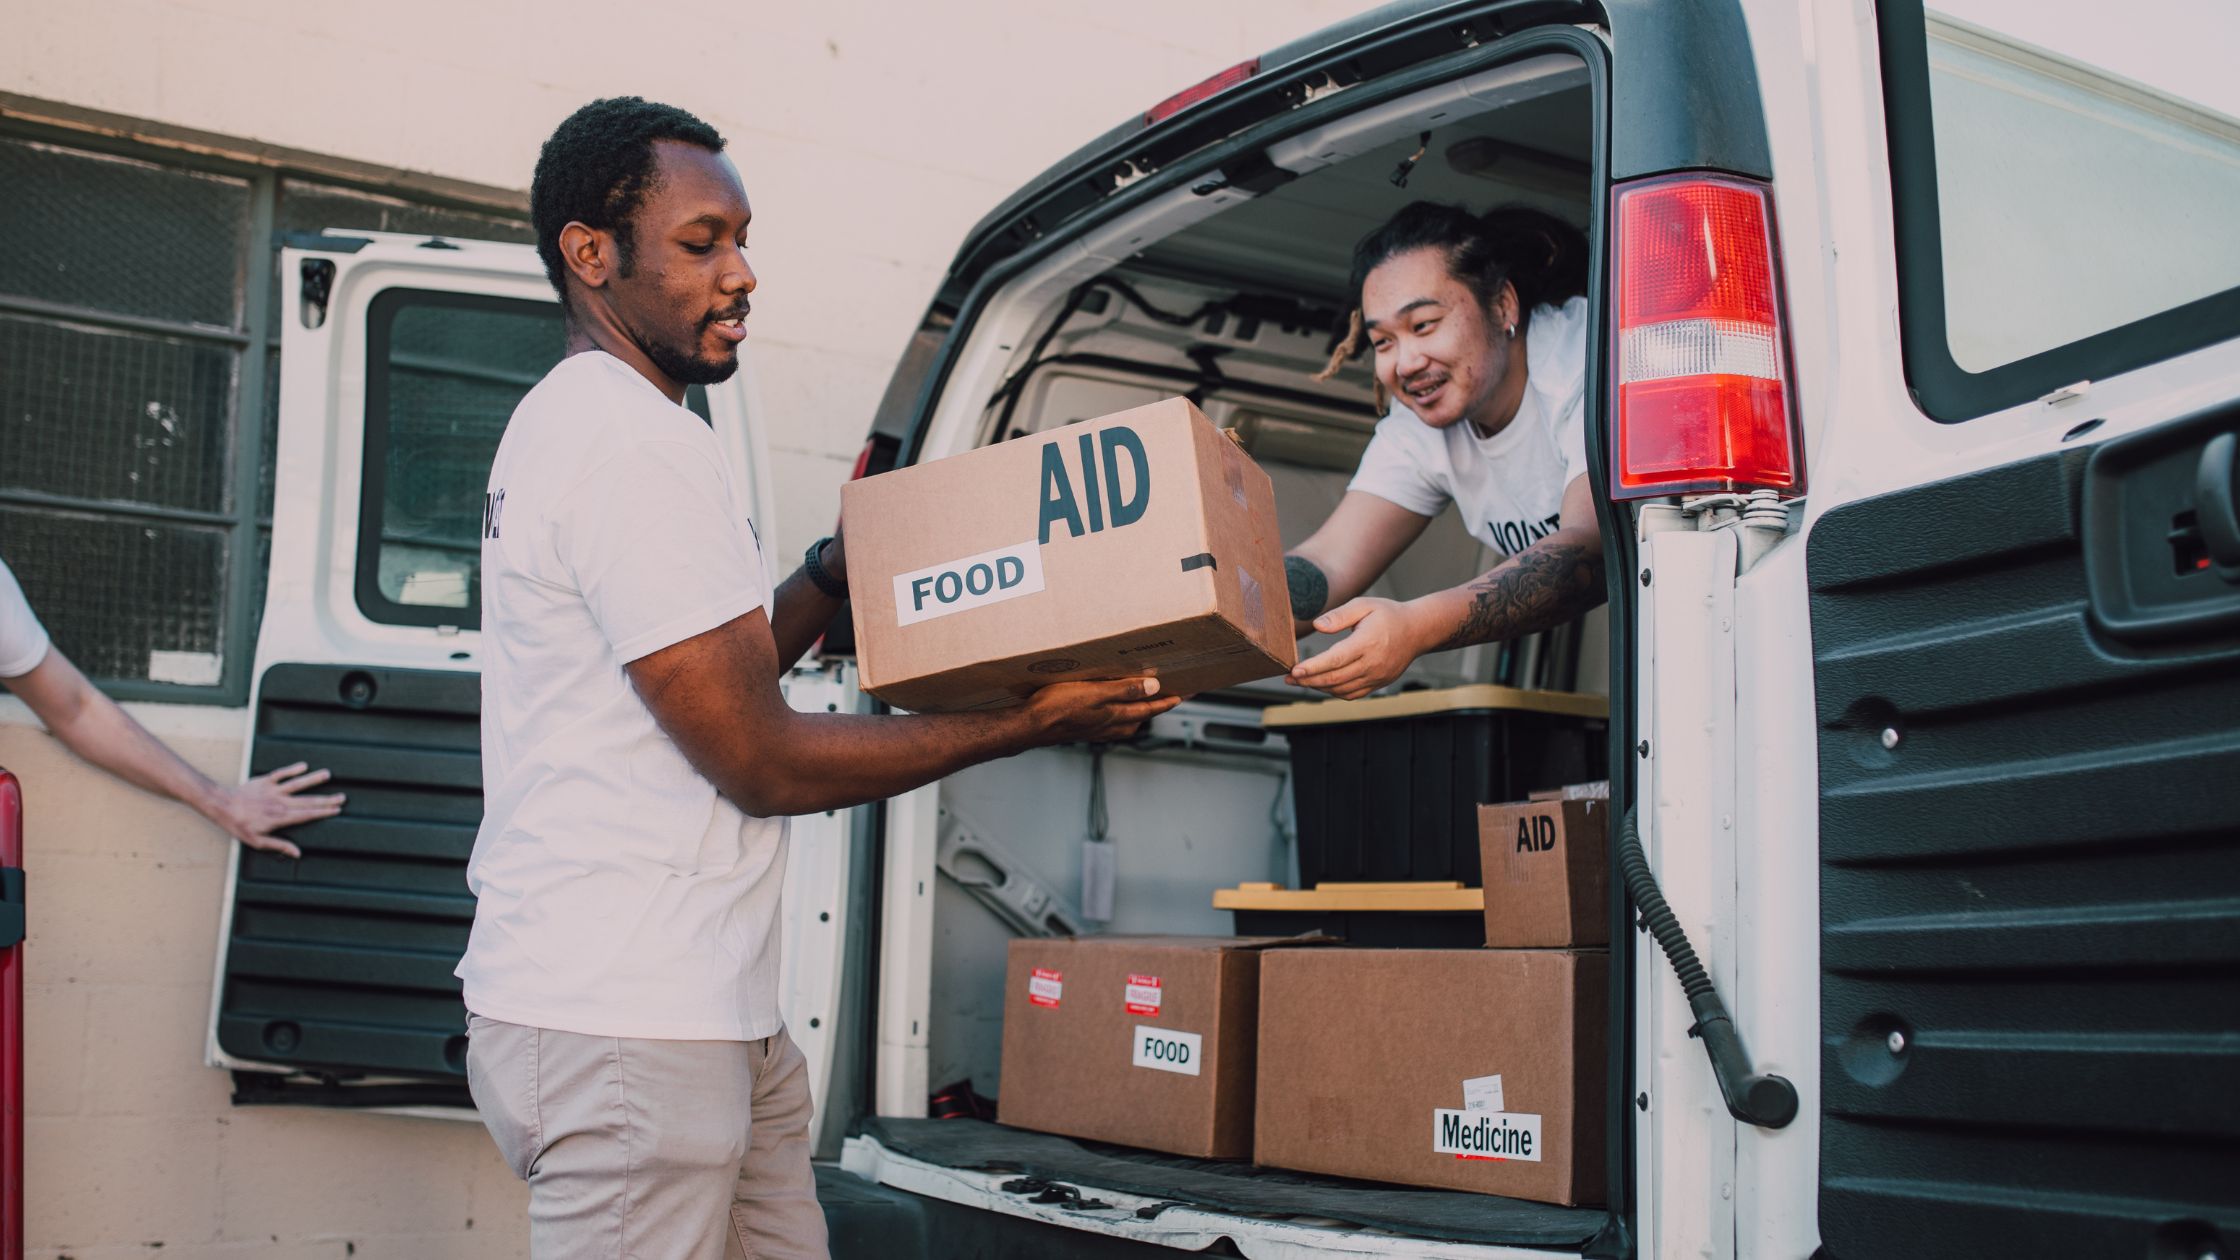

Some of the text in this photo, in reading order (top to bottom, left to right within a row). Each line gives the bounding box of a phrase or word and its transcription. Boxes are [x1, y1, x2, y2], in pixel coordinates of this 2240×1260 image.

[1037, 426, 1151, 545] AID
[911, 556, 1025, 612] FOOD
[1517, 815, 1556, 853] AID
[1144, 1037, 1190, 1064] FOOD
[1442, 1113, 1532, 1156] Medicine
